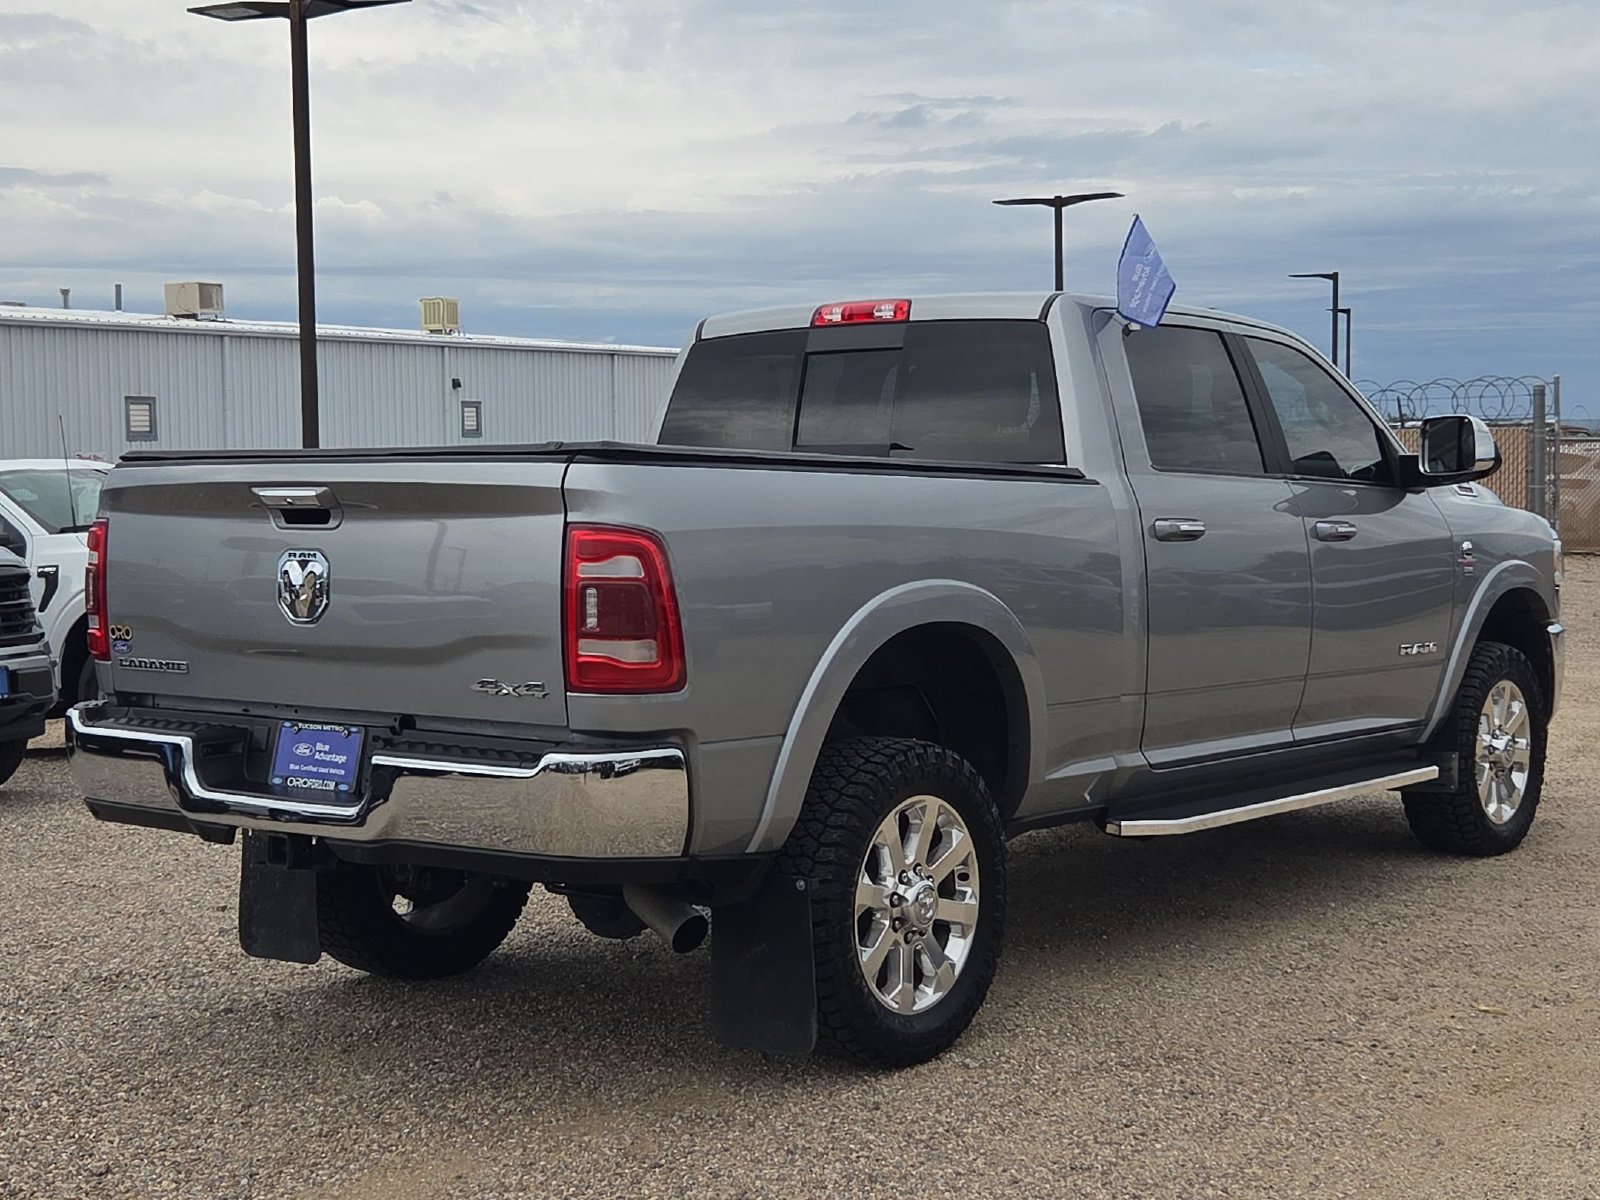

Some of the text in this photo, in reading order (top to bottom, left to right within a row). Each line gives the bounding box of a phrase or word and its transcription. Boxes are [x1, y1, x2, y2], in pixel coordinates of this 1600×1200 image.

[109, 625, 132, 640] ORO
[1399, 641, 1438, 656] RAM
[118, 656, 189, 674] LARAMIE
[298, 722, 345, 732] TUCSON METRO
[315, 742, 330, 752] Blue
[314, 752, 347, 764] Advantage
[300, 764, 318, 772] Certified
